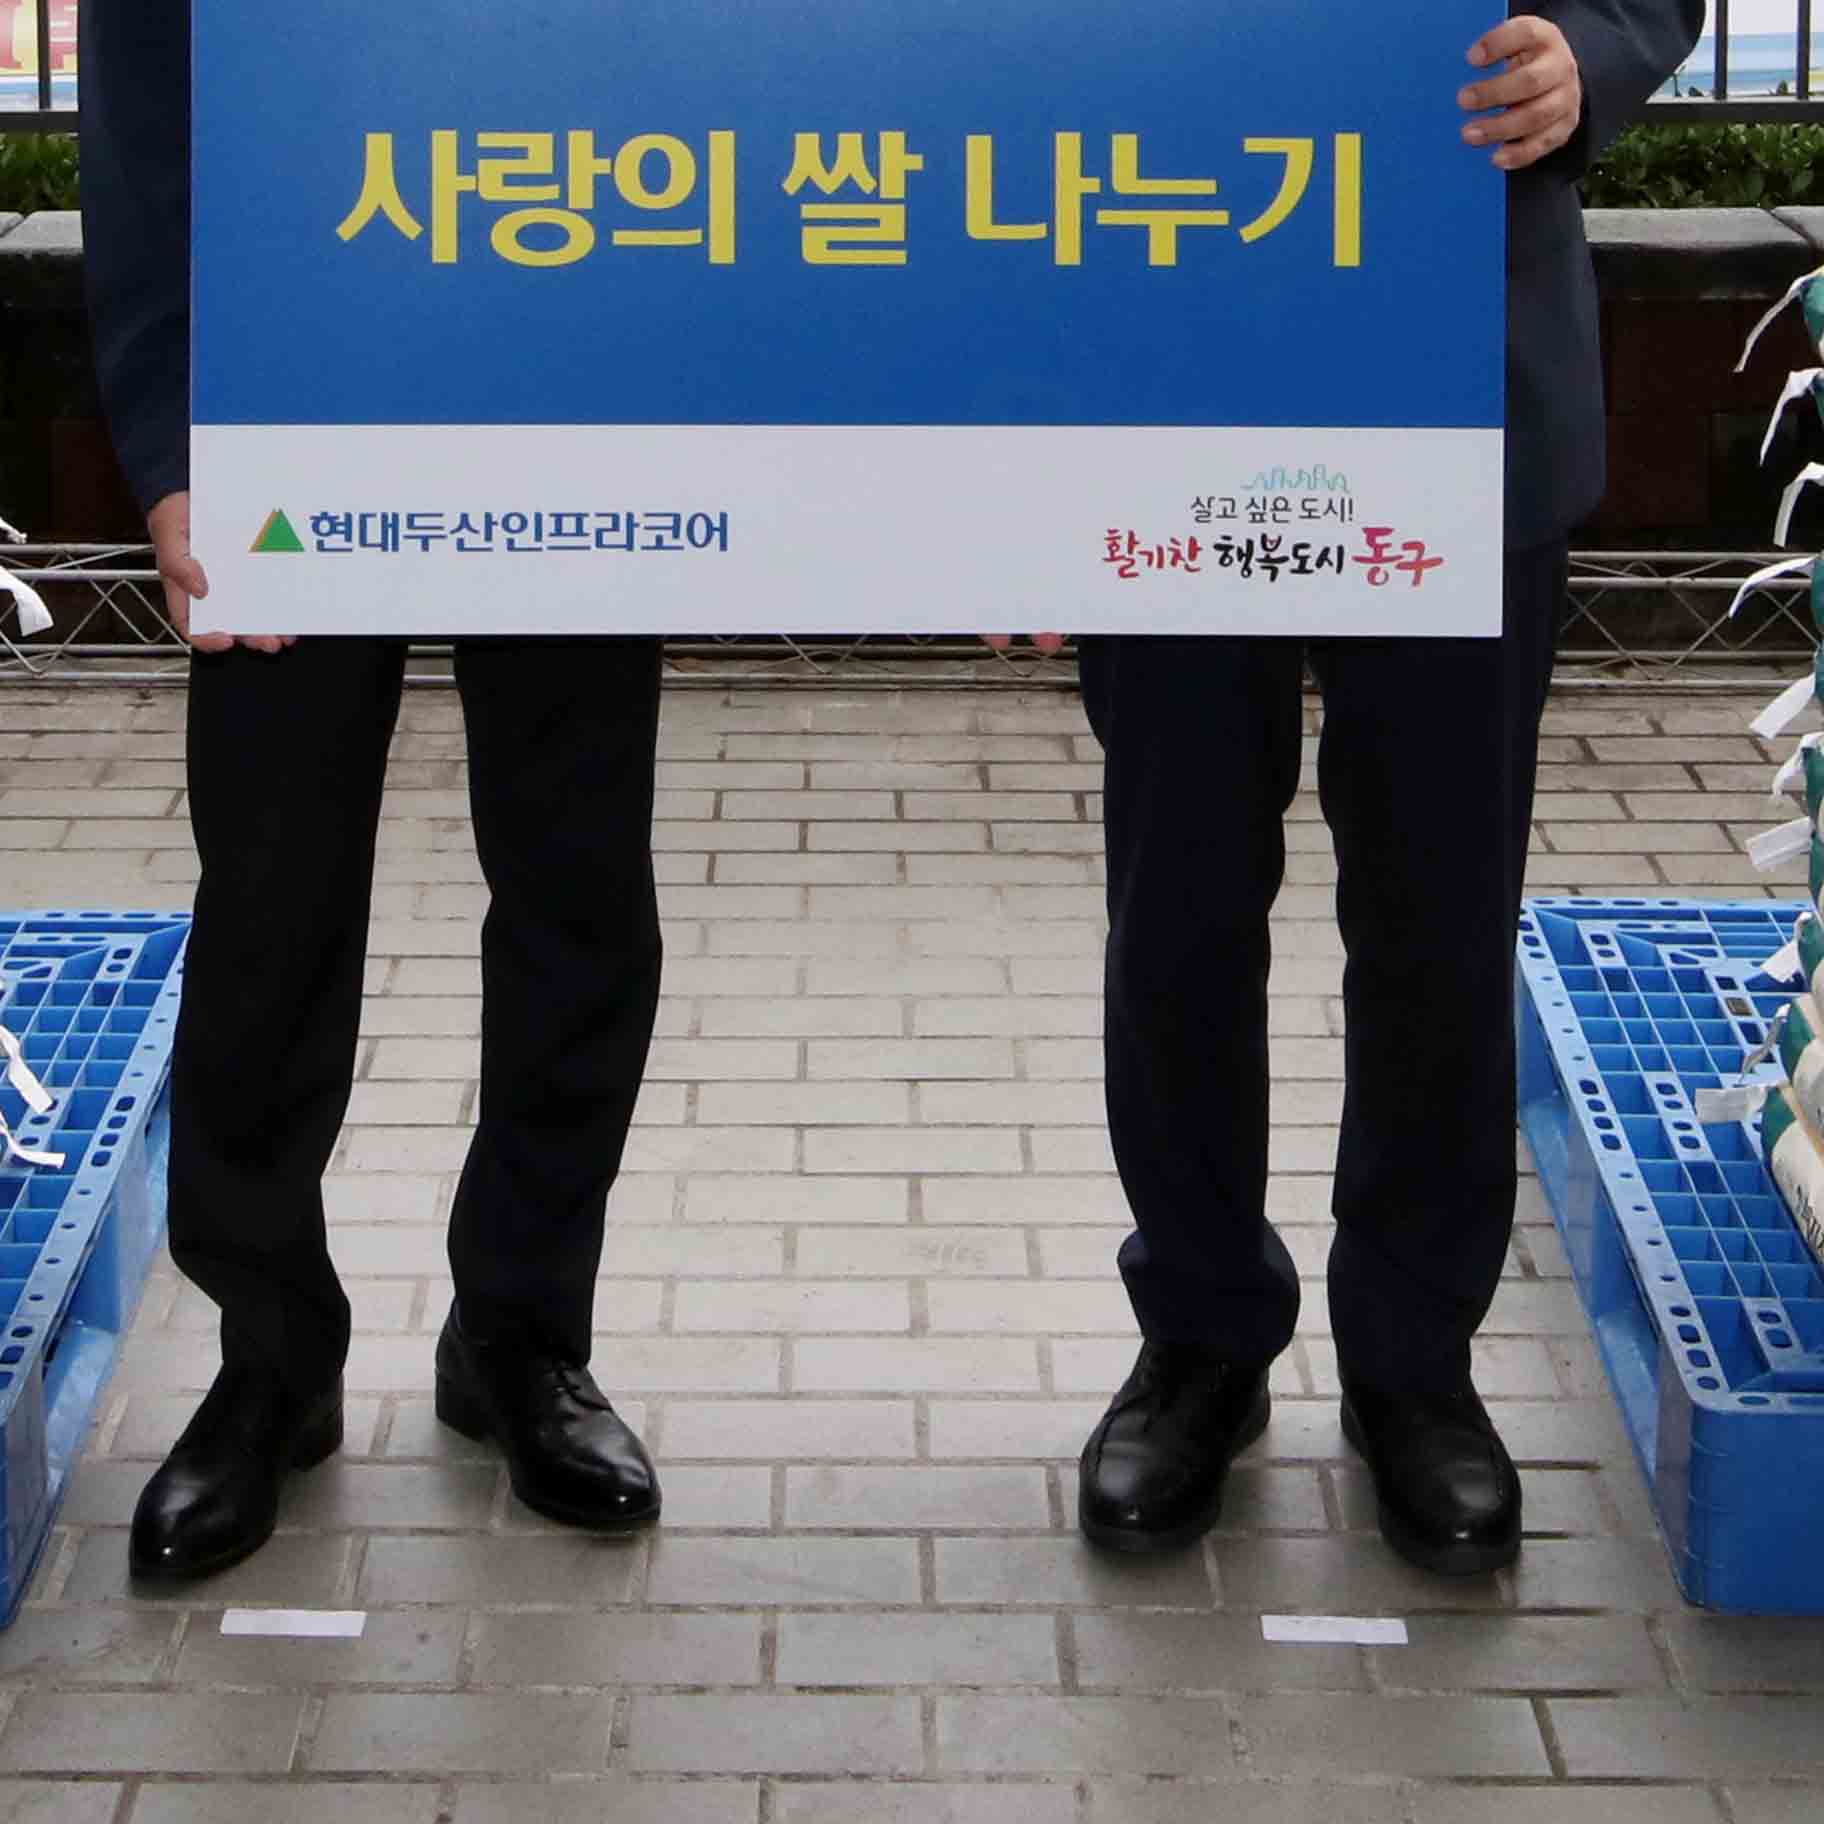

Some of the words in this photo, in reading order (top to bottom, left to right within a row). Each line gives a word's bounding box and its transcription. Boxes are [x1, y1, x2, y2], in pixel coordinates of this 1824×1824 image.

[339, 131, 736, 268] 사랑의
[786, 132, 924, 266] 쌀
[967, 132, 1362, 268] 나누기
[310, 511, 729, 554] 현대두산인프라코어
[1191, 496, 1238, 523] 살고
[1245, 497, 1292, 524] 싶은
[1299, 497, 1354, 523] 도시!
[1102, 528, 1202, 579] 활기찬
[1213, 533, 1345, 582] 행복도시
[1352, 527, 1444, 587] 동구
